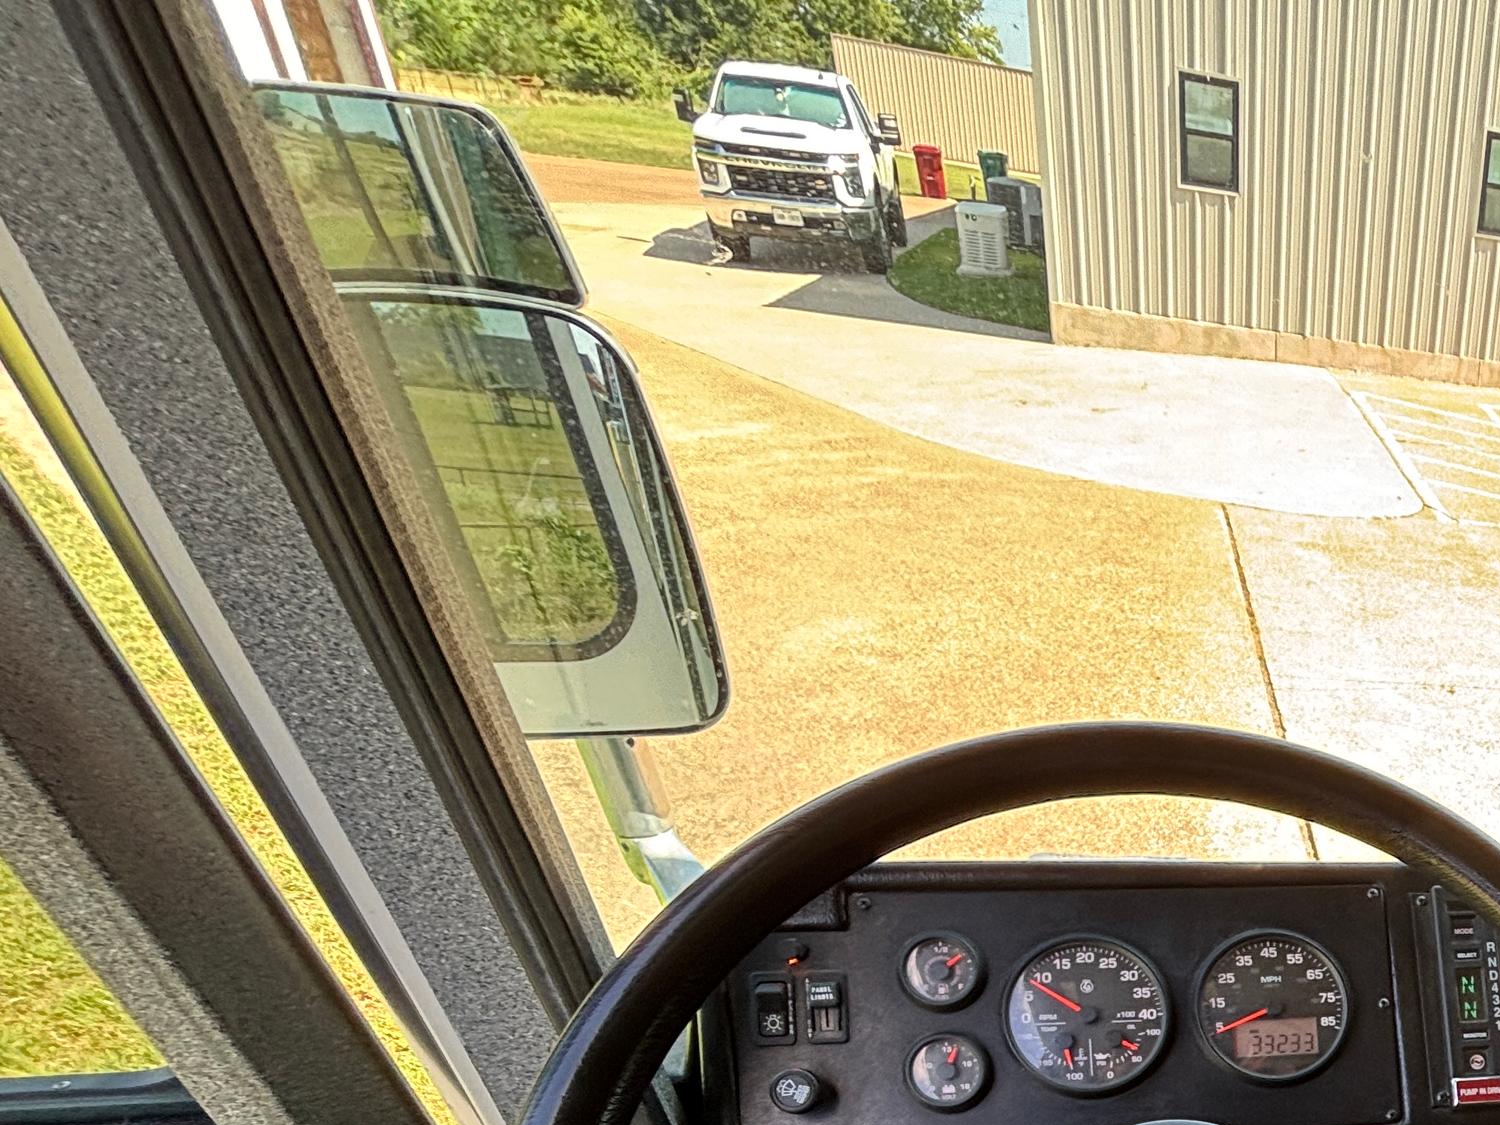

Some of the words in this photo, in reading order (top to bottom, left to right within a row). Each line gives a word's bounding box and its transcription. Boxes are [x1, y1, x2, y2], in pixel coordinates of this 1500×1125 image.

[1260, 947, 1277, 957] 45
[1486, 942, 1496, 953] R
[1076, 952, 1094, 963] 20
[1236, 956, 1252, 967] 35
[1286, 954, 1303, 964] 55
[1488, 957, 1497, 967] N
[1053, 959, 1071, 970] 15
[1099, 958, 1117, 968] 25
[1034, 972, 1052, 983] 10
[1120, 971, 1138, 981] 30
[1218, 973, 1235, 983] 25
[1260, 975, 1282, 983] MPH
[1306, 969, 1323, 980] 65
[1489, 970, 1498, 981] D
[1461, 976, 1475, 994] N
[1491, 983, 1499, 993] 4
[1024, 991, 1033, 1002] 5
[1133, 988, 1150, 998] 35
[1319, 993, 1336, 1003] 75
[1209, 998, 1225, 1008] 15
[1492, 995, 1500, 1006] 3
[1139, 1009, 1156, 1019] 40
[1464, 1001, 1477, 1019] N
[1022, 1013, 1030, 1024] 0
[1321, 1017, 1336, 1026] 85
[1252, 1033, 1314, 1055] 33233
[1107, 1071, 1114, 1079] 0
[1460, 1088, 1478, 1096] PUMP
